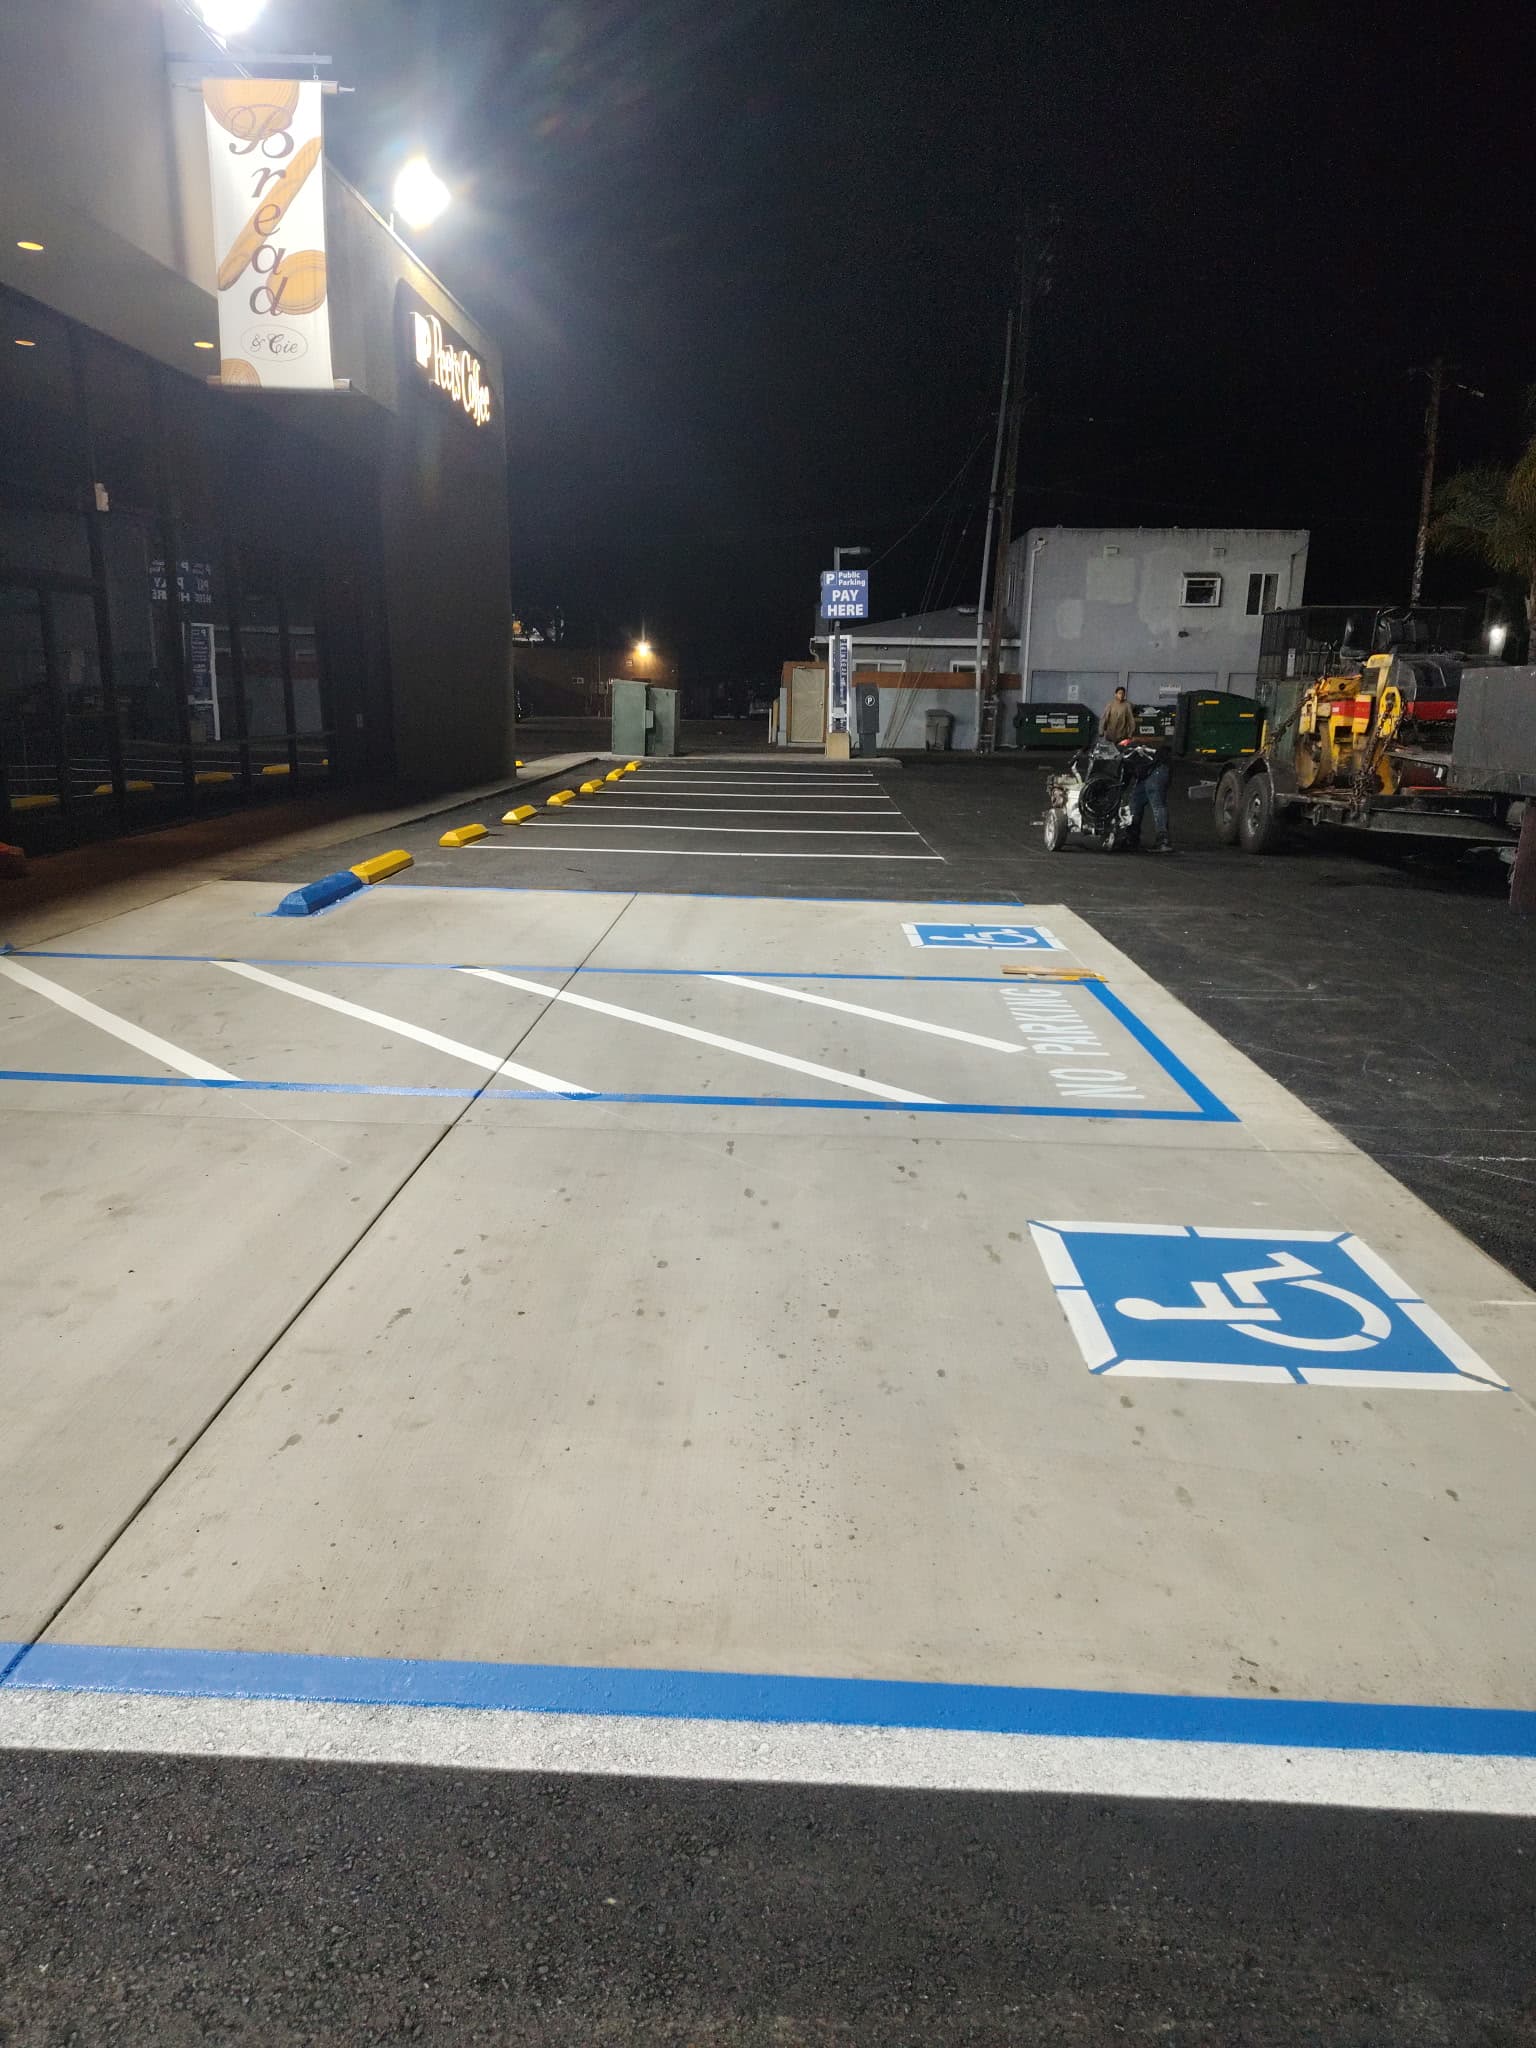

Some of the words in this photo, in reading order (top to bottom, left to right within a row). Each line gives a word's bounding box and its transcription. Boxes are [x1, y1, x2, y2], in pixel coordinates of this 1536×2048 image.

[267, 333, 298, 355] Cie
[826, 573, 835, 585] P
[838, 571, 861, 579] Public
[838, 579, 866, 587] Parking
[832, 589, 859, 602] PAY
[827, 603, 864, 617] HERE
[1000, 988, 1111, 1056] PARKING
[1048, 1068, 1146, 1099] NO
